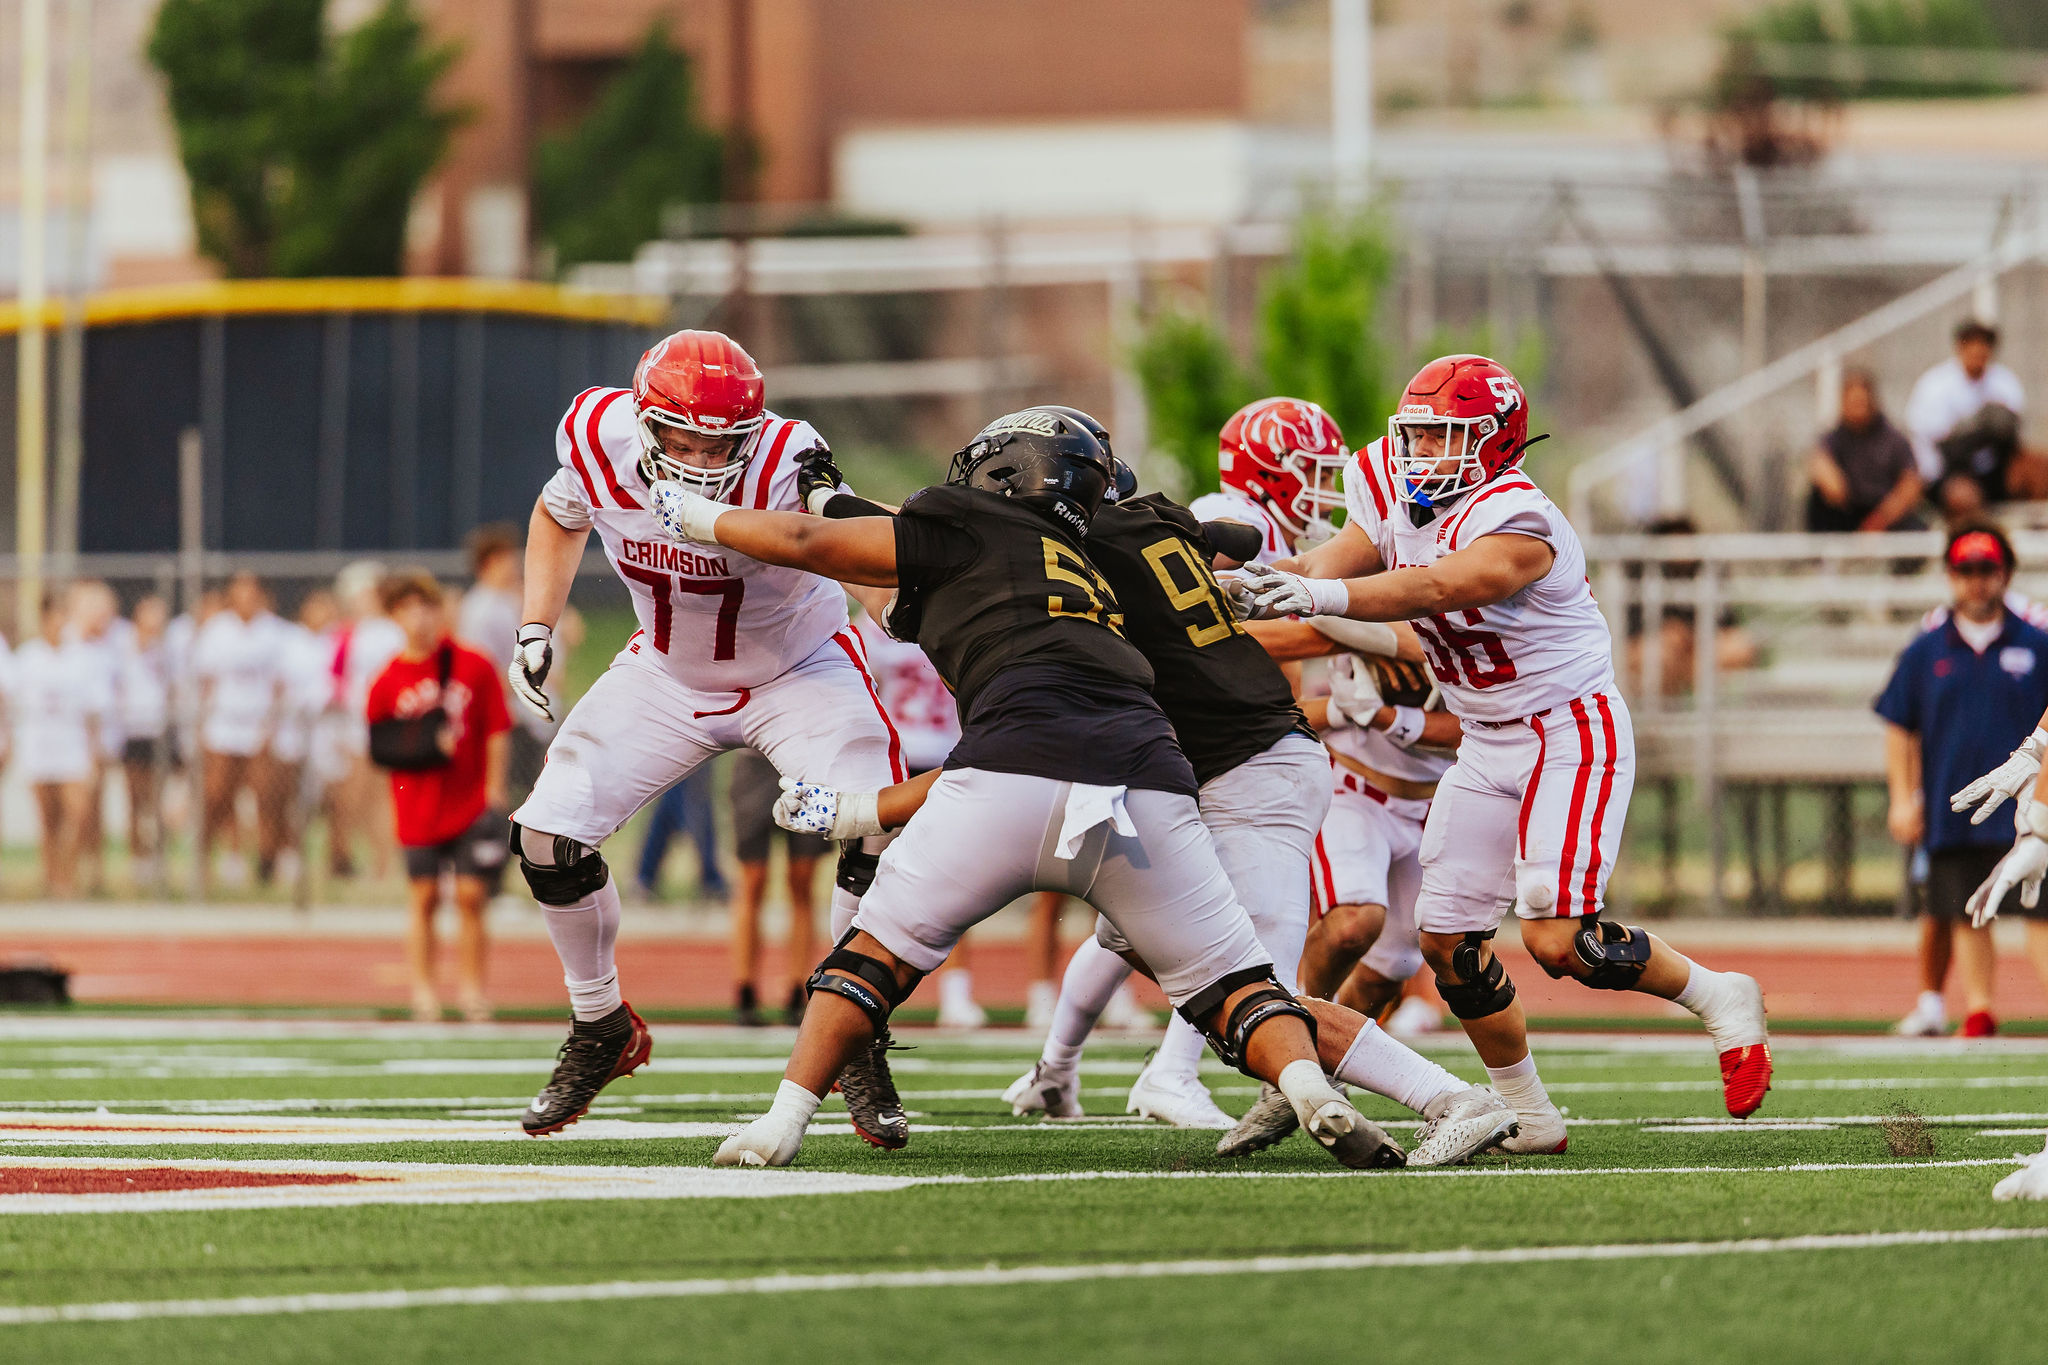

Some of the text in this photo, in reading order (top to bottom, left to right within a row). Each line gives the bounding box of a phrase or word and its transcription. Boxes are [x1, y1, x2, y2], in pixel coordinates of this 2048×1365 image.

[622, 538, 730, 577] CRIMSON
[617, 558, 745, 661] 77
[841, 981, 879, 1009] DONJOY
